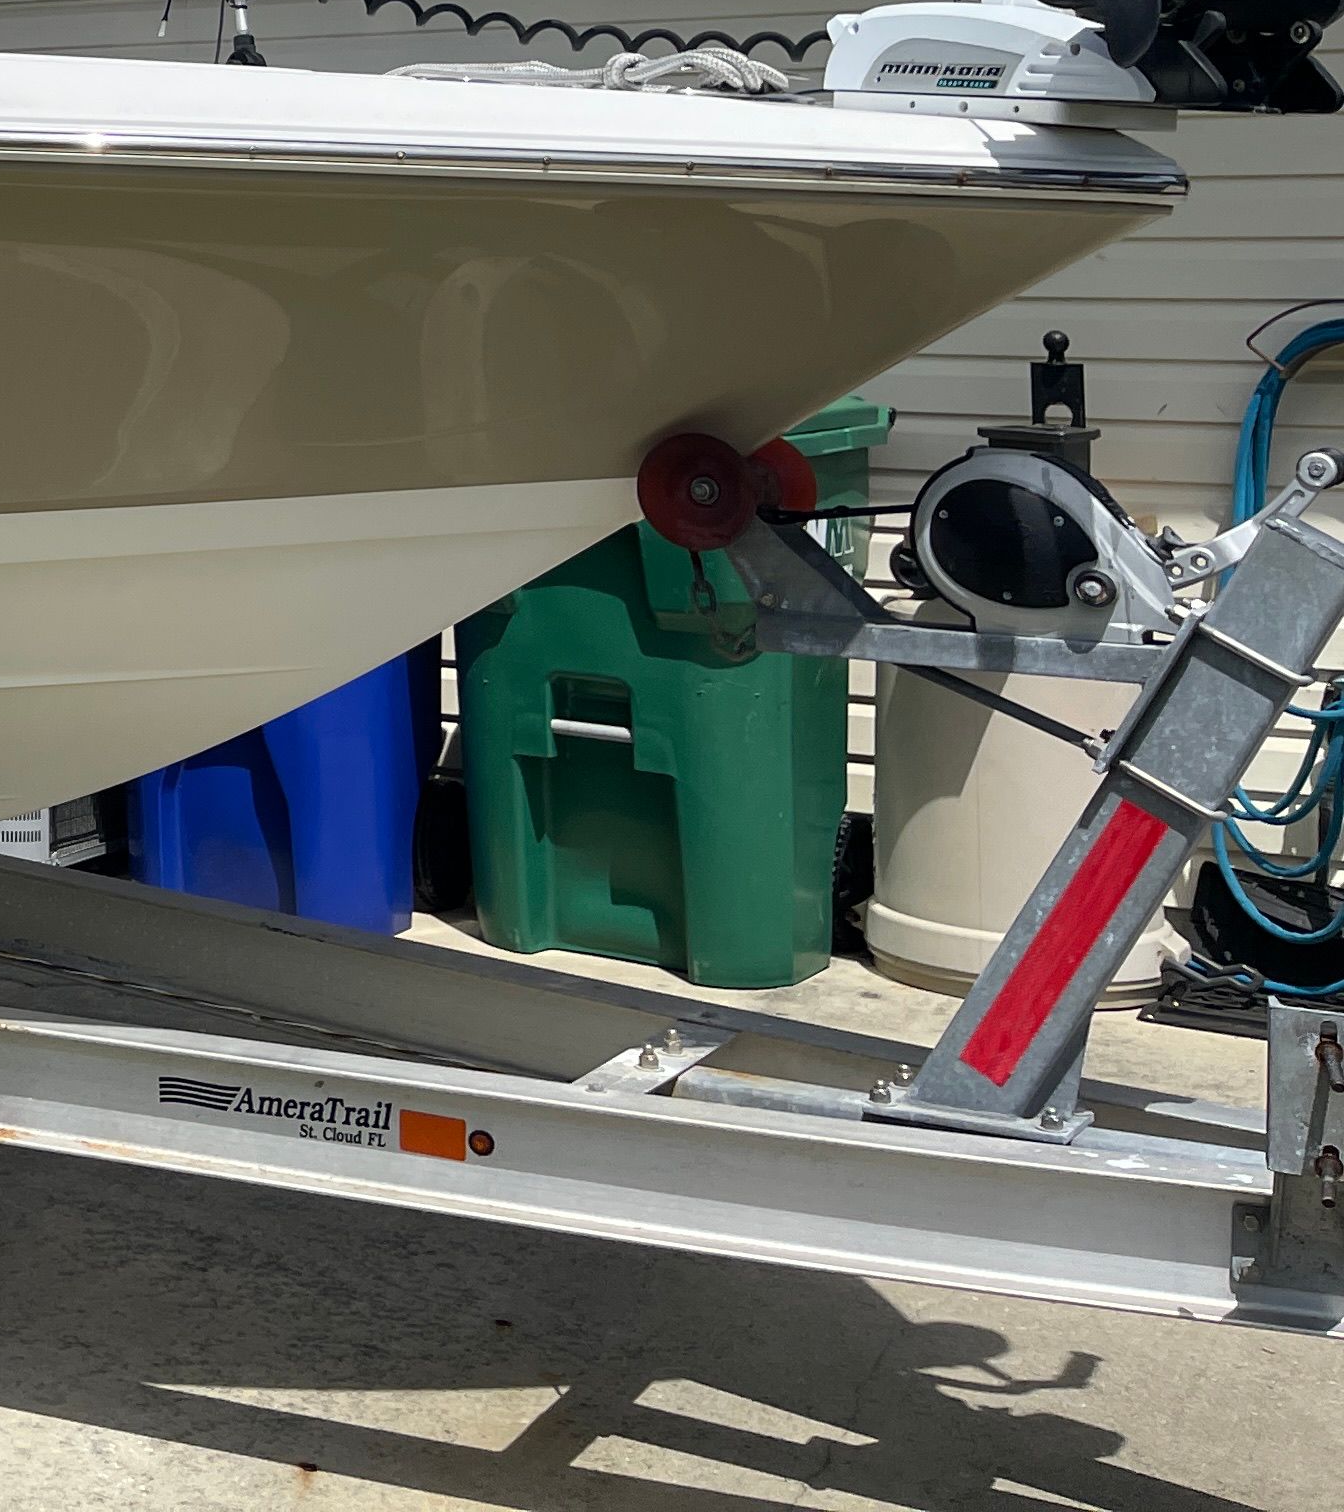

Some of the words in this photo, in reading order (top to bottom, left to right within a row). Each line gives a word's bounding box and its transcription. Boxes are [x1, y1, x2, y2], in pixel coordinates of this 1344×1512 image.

[942, 65, 1002, 77] KOTA
[233, 1088, 393, 1130] AmeraTrail
[299, 1124, 318, 1139] St.
[322, 1126, 362, 1144] Cloud
[367, 1132, 386, 1147] FL
